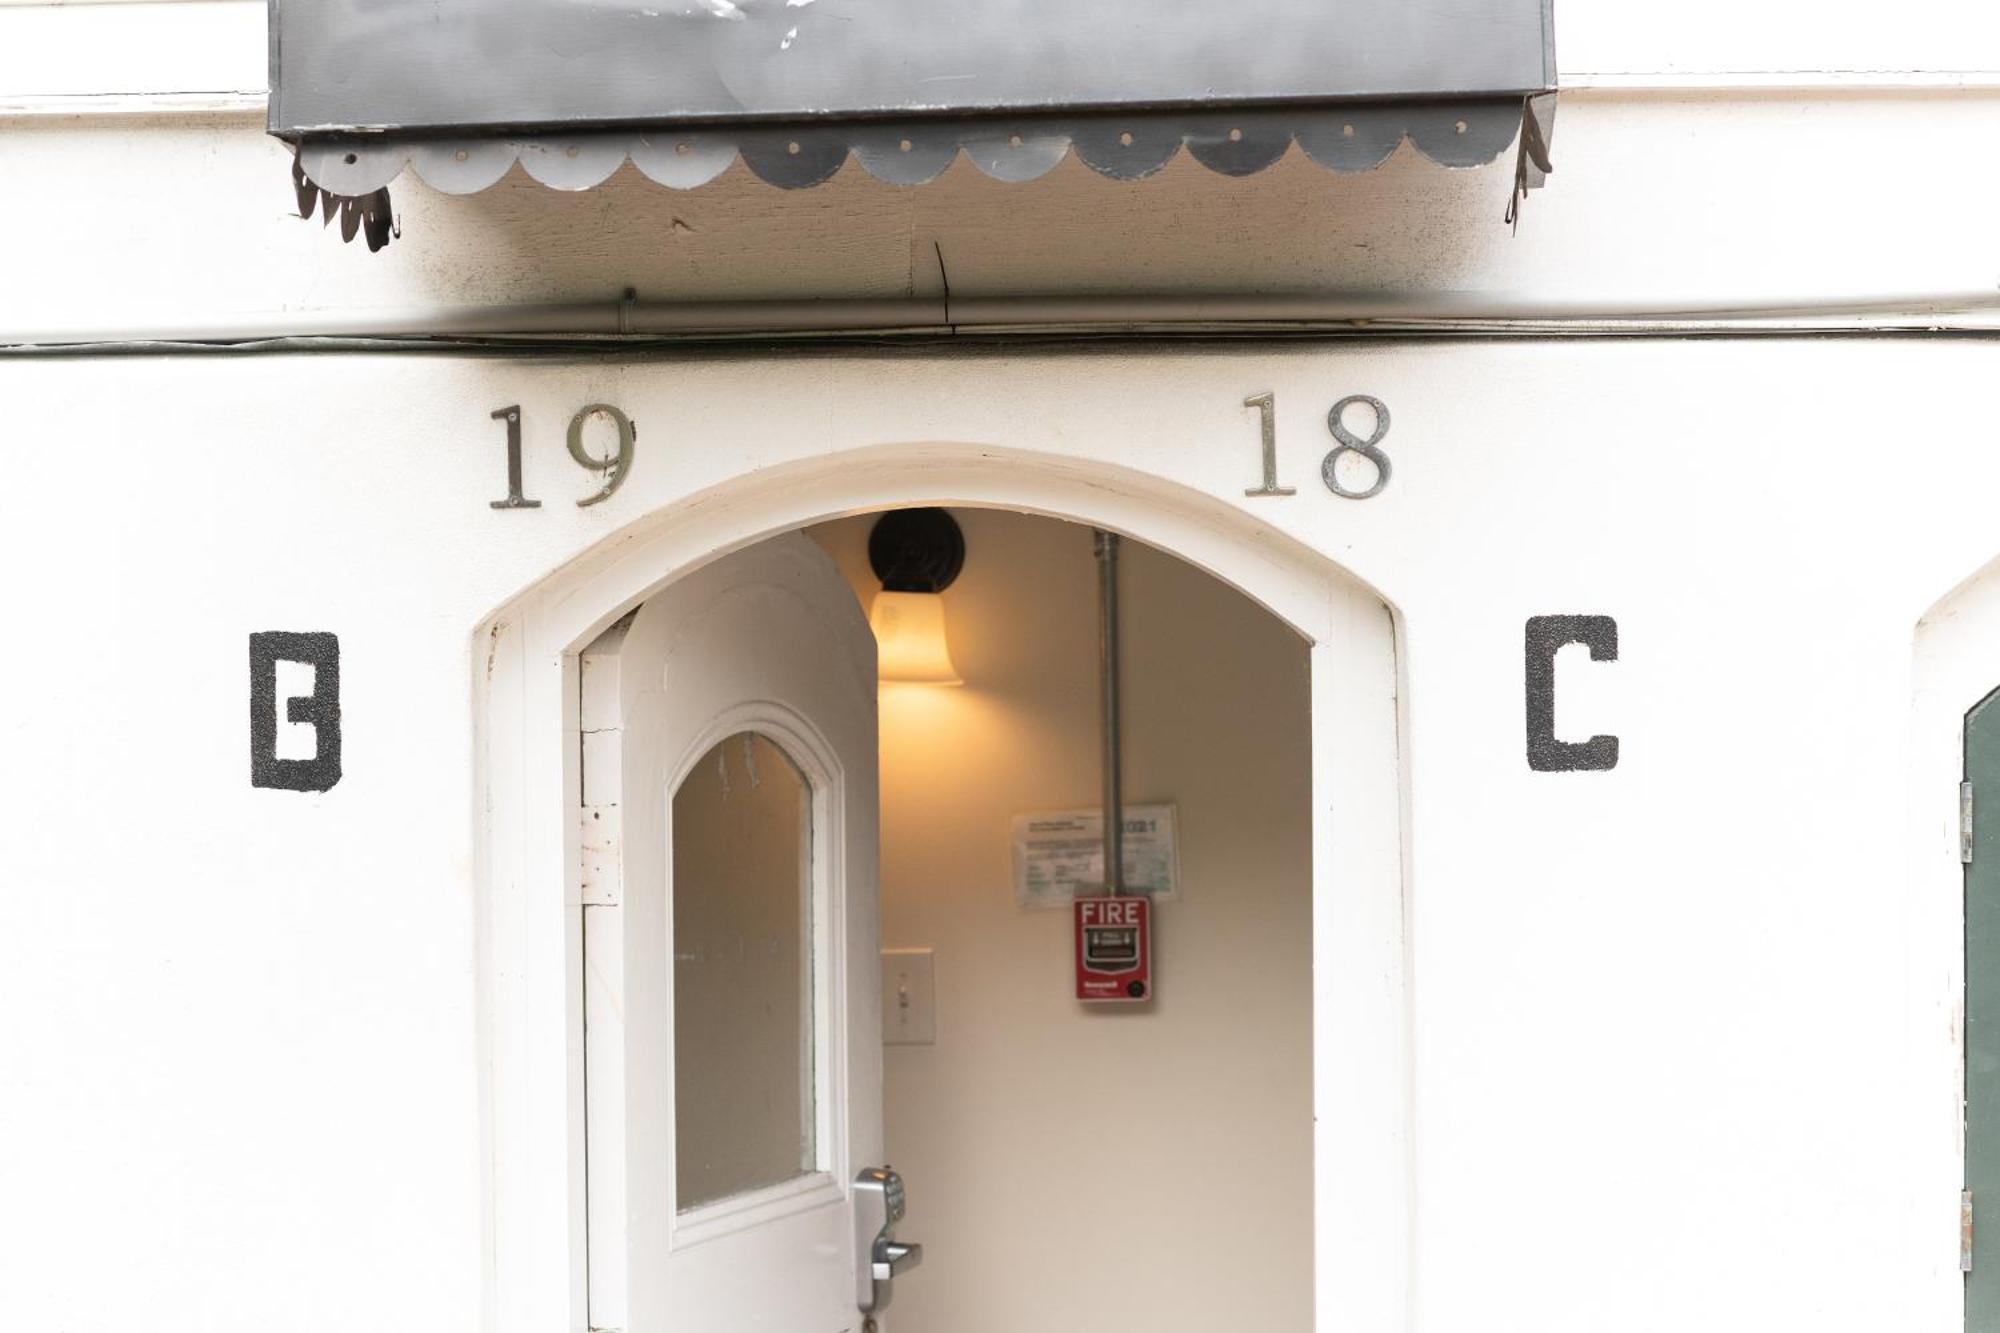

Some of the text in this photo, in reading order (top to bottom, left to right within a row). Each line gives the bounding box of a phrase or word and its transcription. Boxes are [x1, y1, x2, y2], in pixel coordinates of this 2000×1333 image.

[491, 392, 1391, 510] 19 18
[250, 631, 342, 792] B
[1525, 615, 1619, 772] C
[1081, 902, 1140, 924] FIRE
